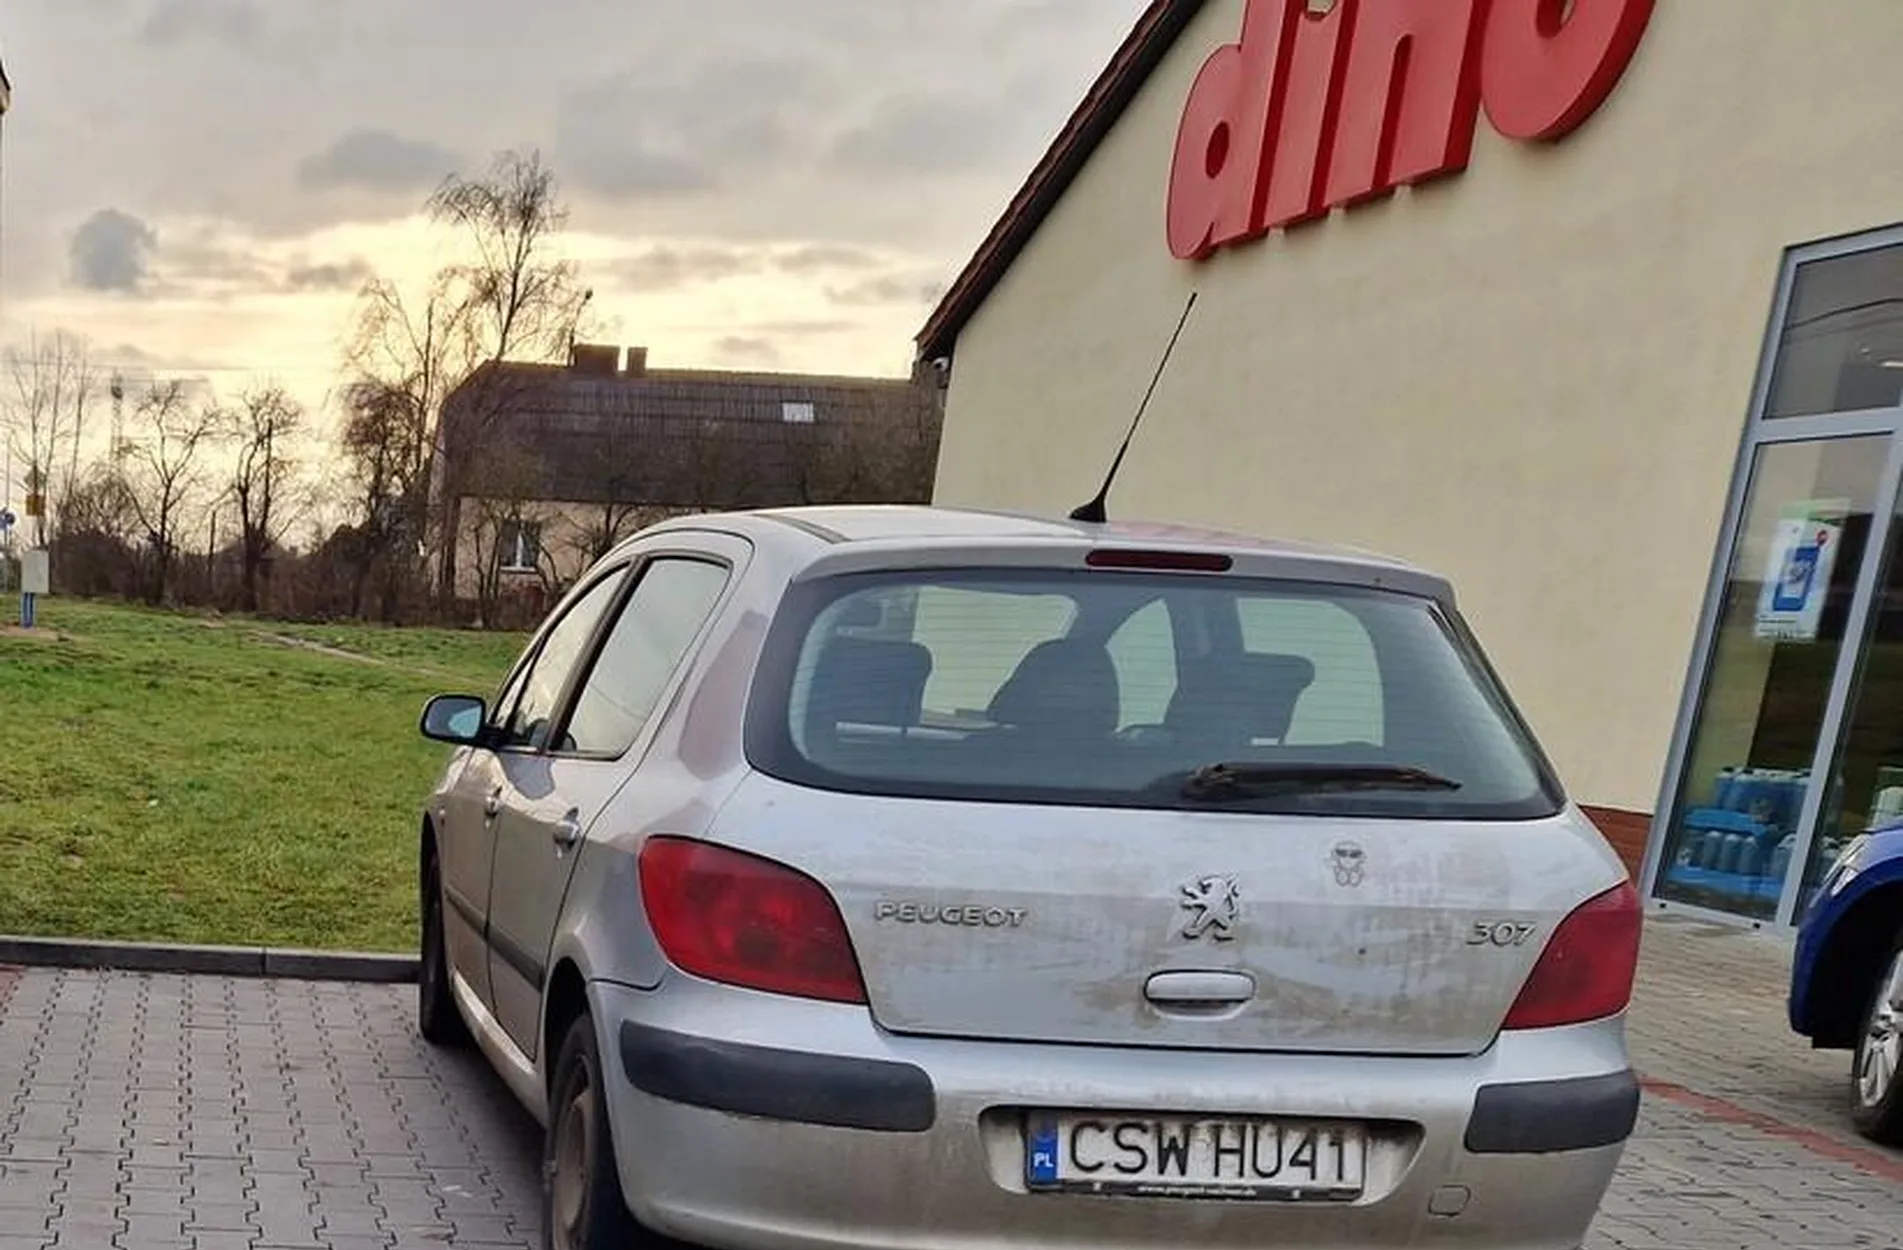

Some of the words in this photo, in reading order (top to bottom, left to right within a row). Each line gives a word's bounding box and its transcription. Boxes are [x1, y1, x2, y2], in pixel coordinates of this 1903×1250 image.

[875, 901, 1027, 927] PEUGEOT
[1466, 920, 1537, 947] 307
[1033, 1152, 1054, 1168] PL
[1070, 1121, 1192, 1178] CSW
[1213, 1124, 1346, 1181] HU41
